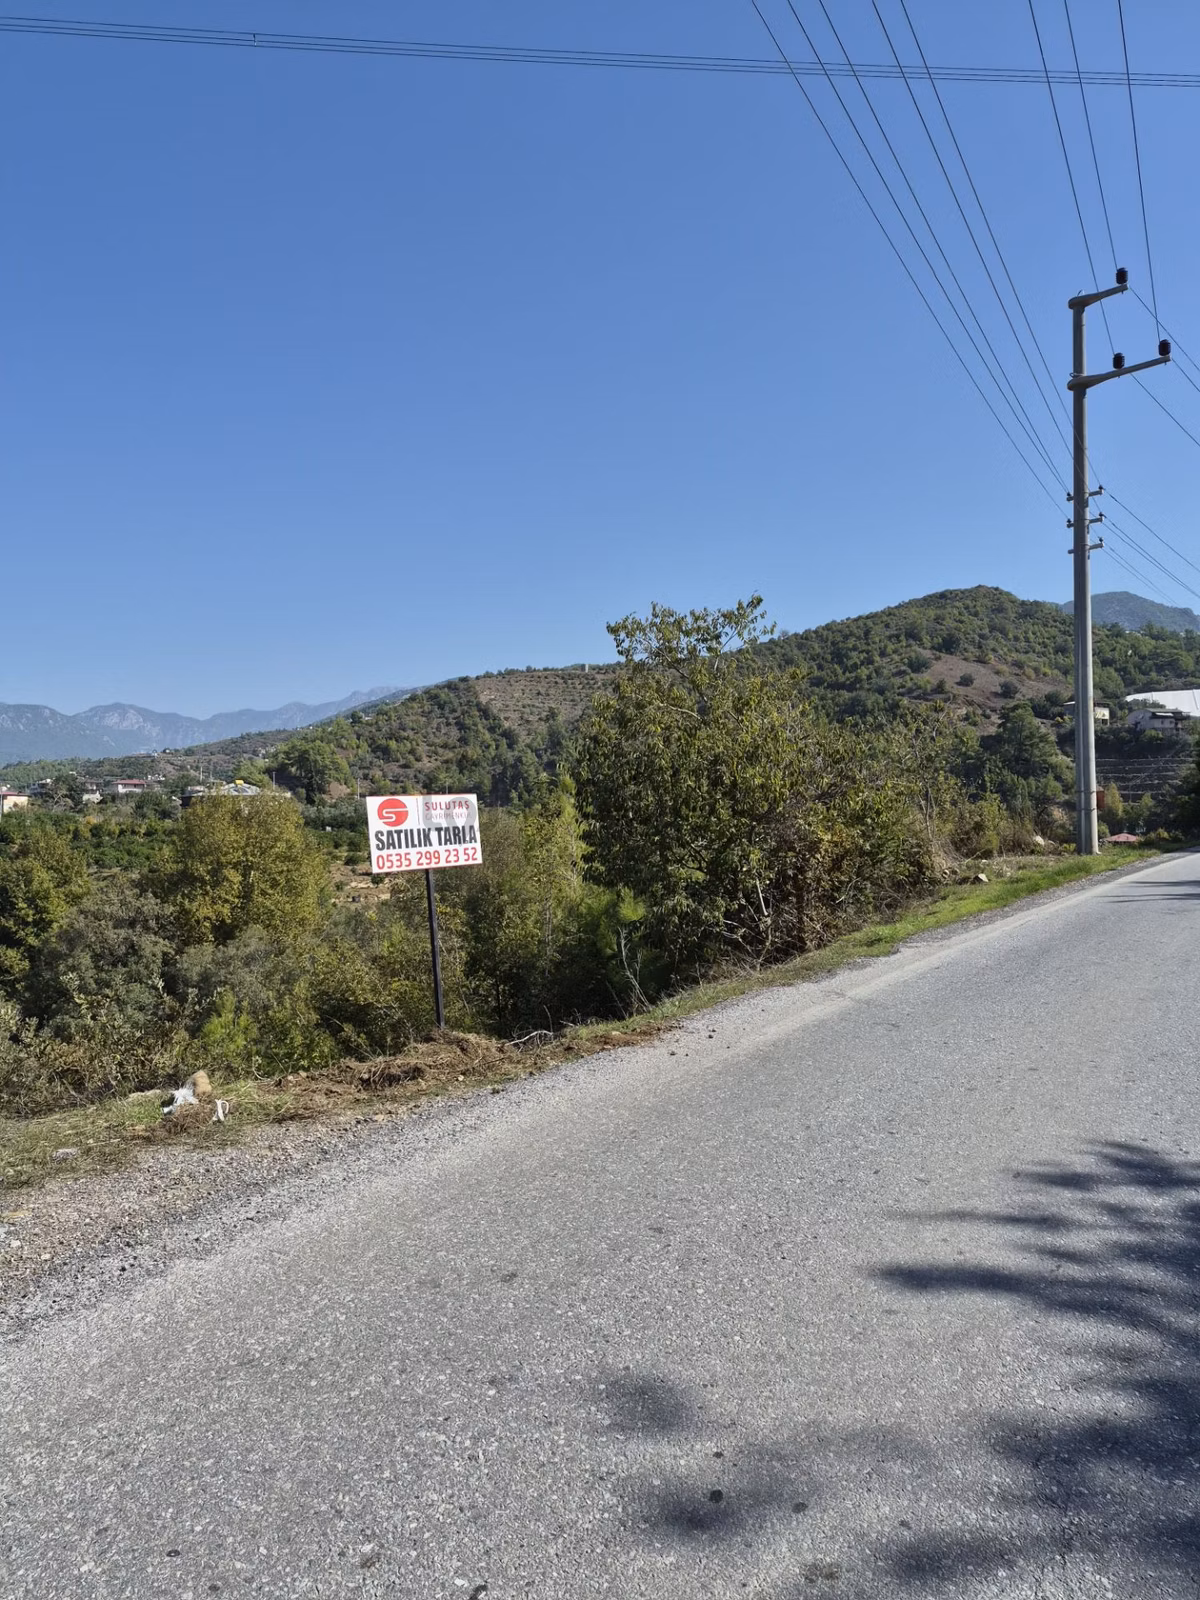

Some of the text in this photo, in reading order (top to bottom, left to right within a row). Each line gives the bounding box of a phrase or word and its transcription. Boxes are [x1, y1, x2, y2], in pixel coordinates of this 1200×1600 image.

[374, 825, 477, 851] SATILIK TARLA
[376, 847, 478, 870] 0535 299 23 52
